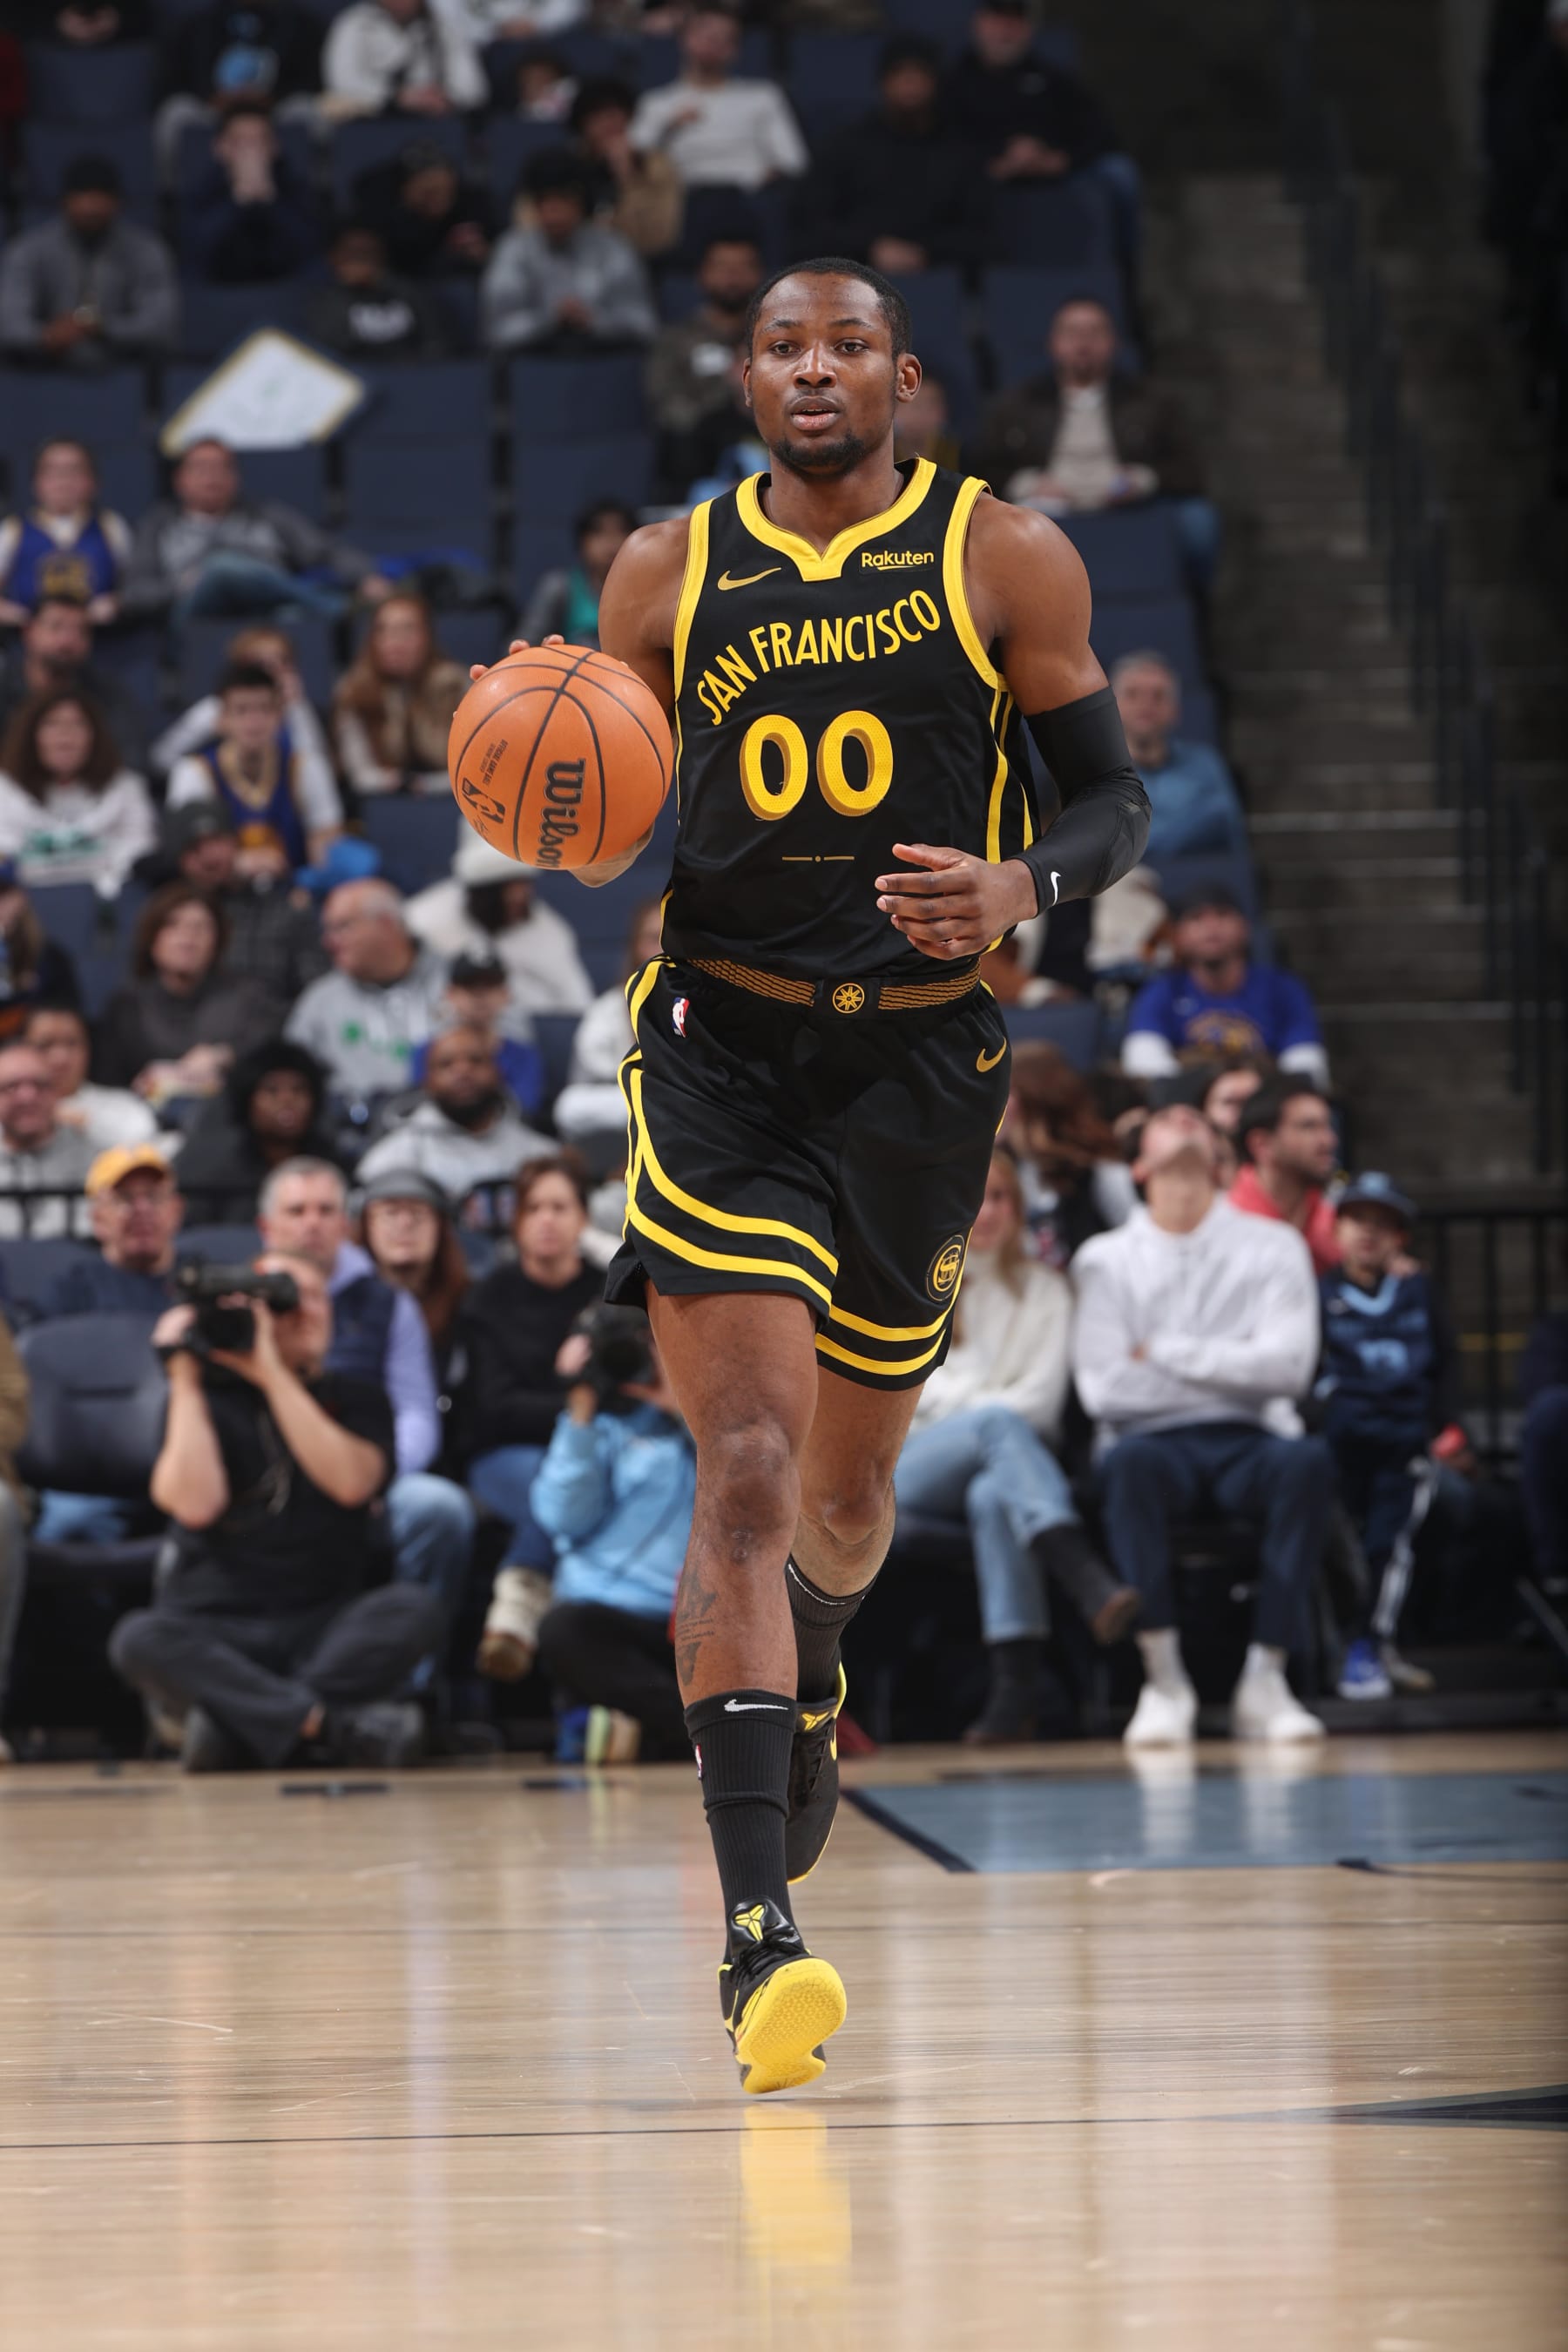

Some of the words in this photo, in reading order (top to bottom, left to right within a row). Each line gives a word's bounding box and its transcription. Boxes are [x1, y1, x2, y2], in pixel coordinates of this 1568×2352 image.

[862, 550, 935, 568] Rakuten
[697, 645, 758, 726] SAN
[748, 590, 941, 673] FRANCISCO
[739, 710, 894, 821] 00
